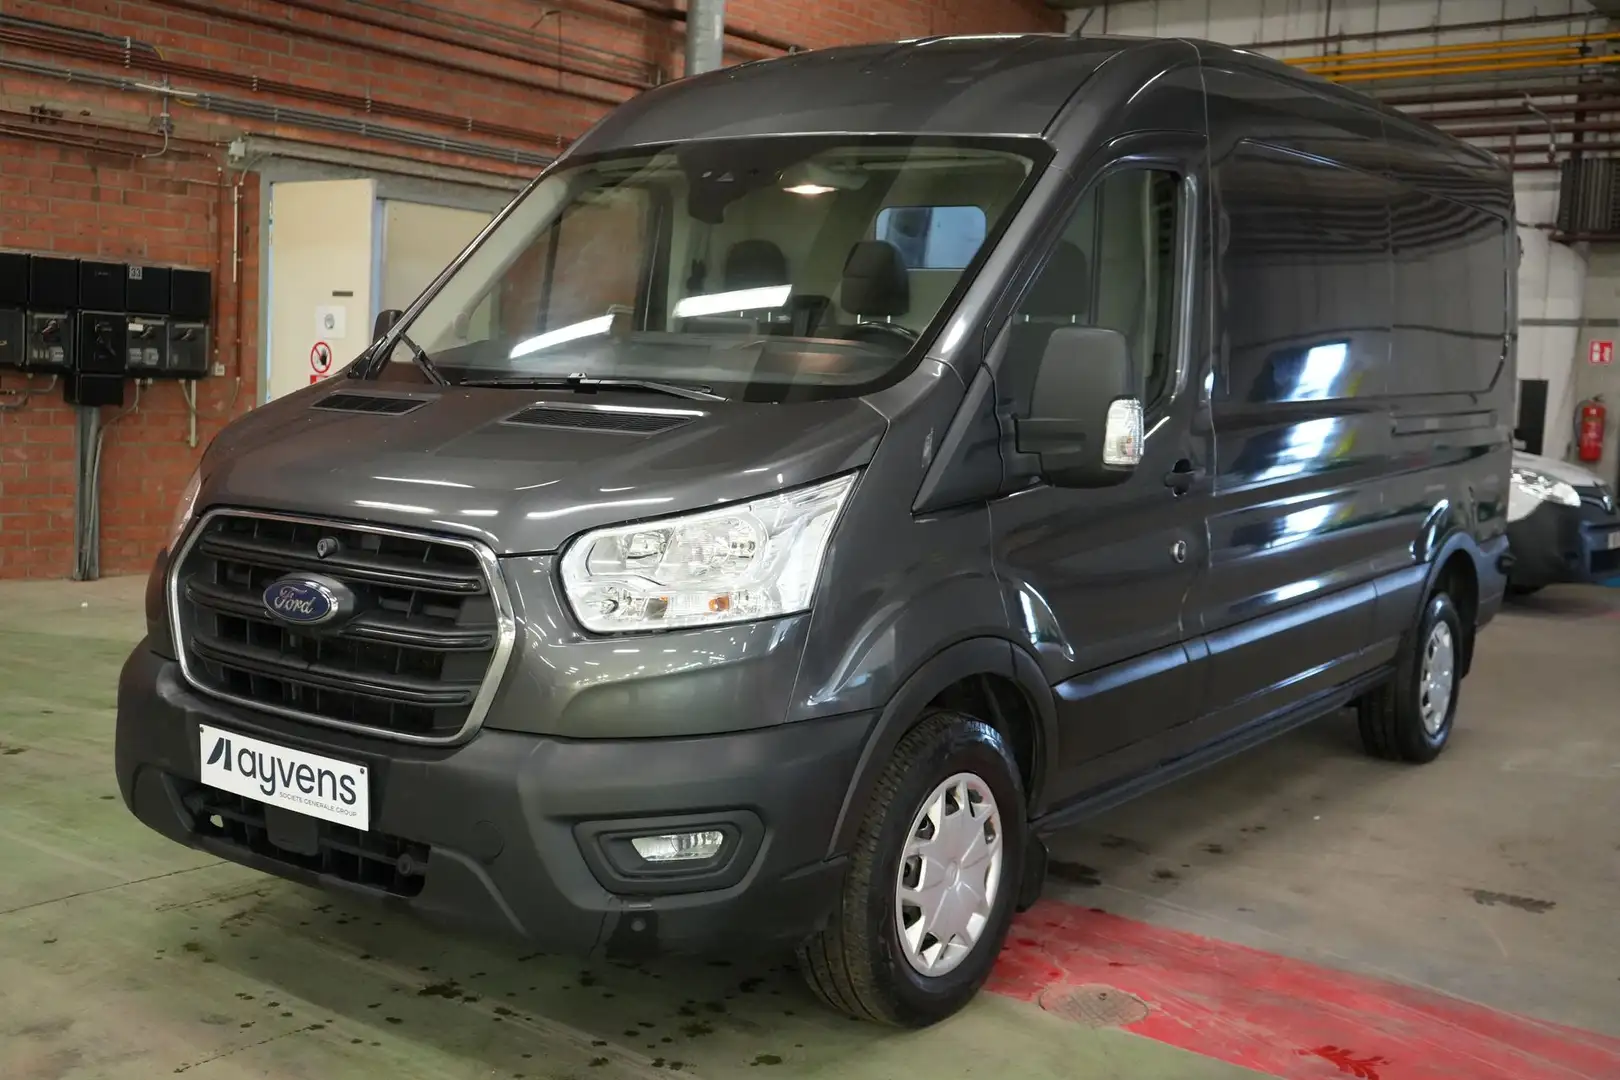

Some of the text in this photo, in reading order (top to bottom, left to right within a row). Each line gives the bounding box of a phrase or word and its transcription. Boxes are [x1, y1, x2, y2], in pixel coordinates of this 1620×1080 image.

[131, 267, 141, 278] 33
[274, 586, 317, 614] Ford
[237, 748, 357, 806] ayvens
[303, 798, 335, 812] GENERALE
[336, 806, 358, 818] GROUP
